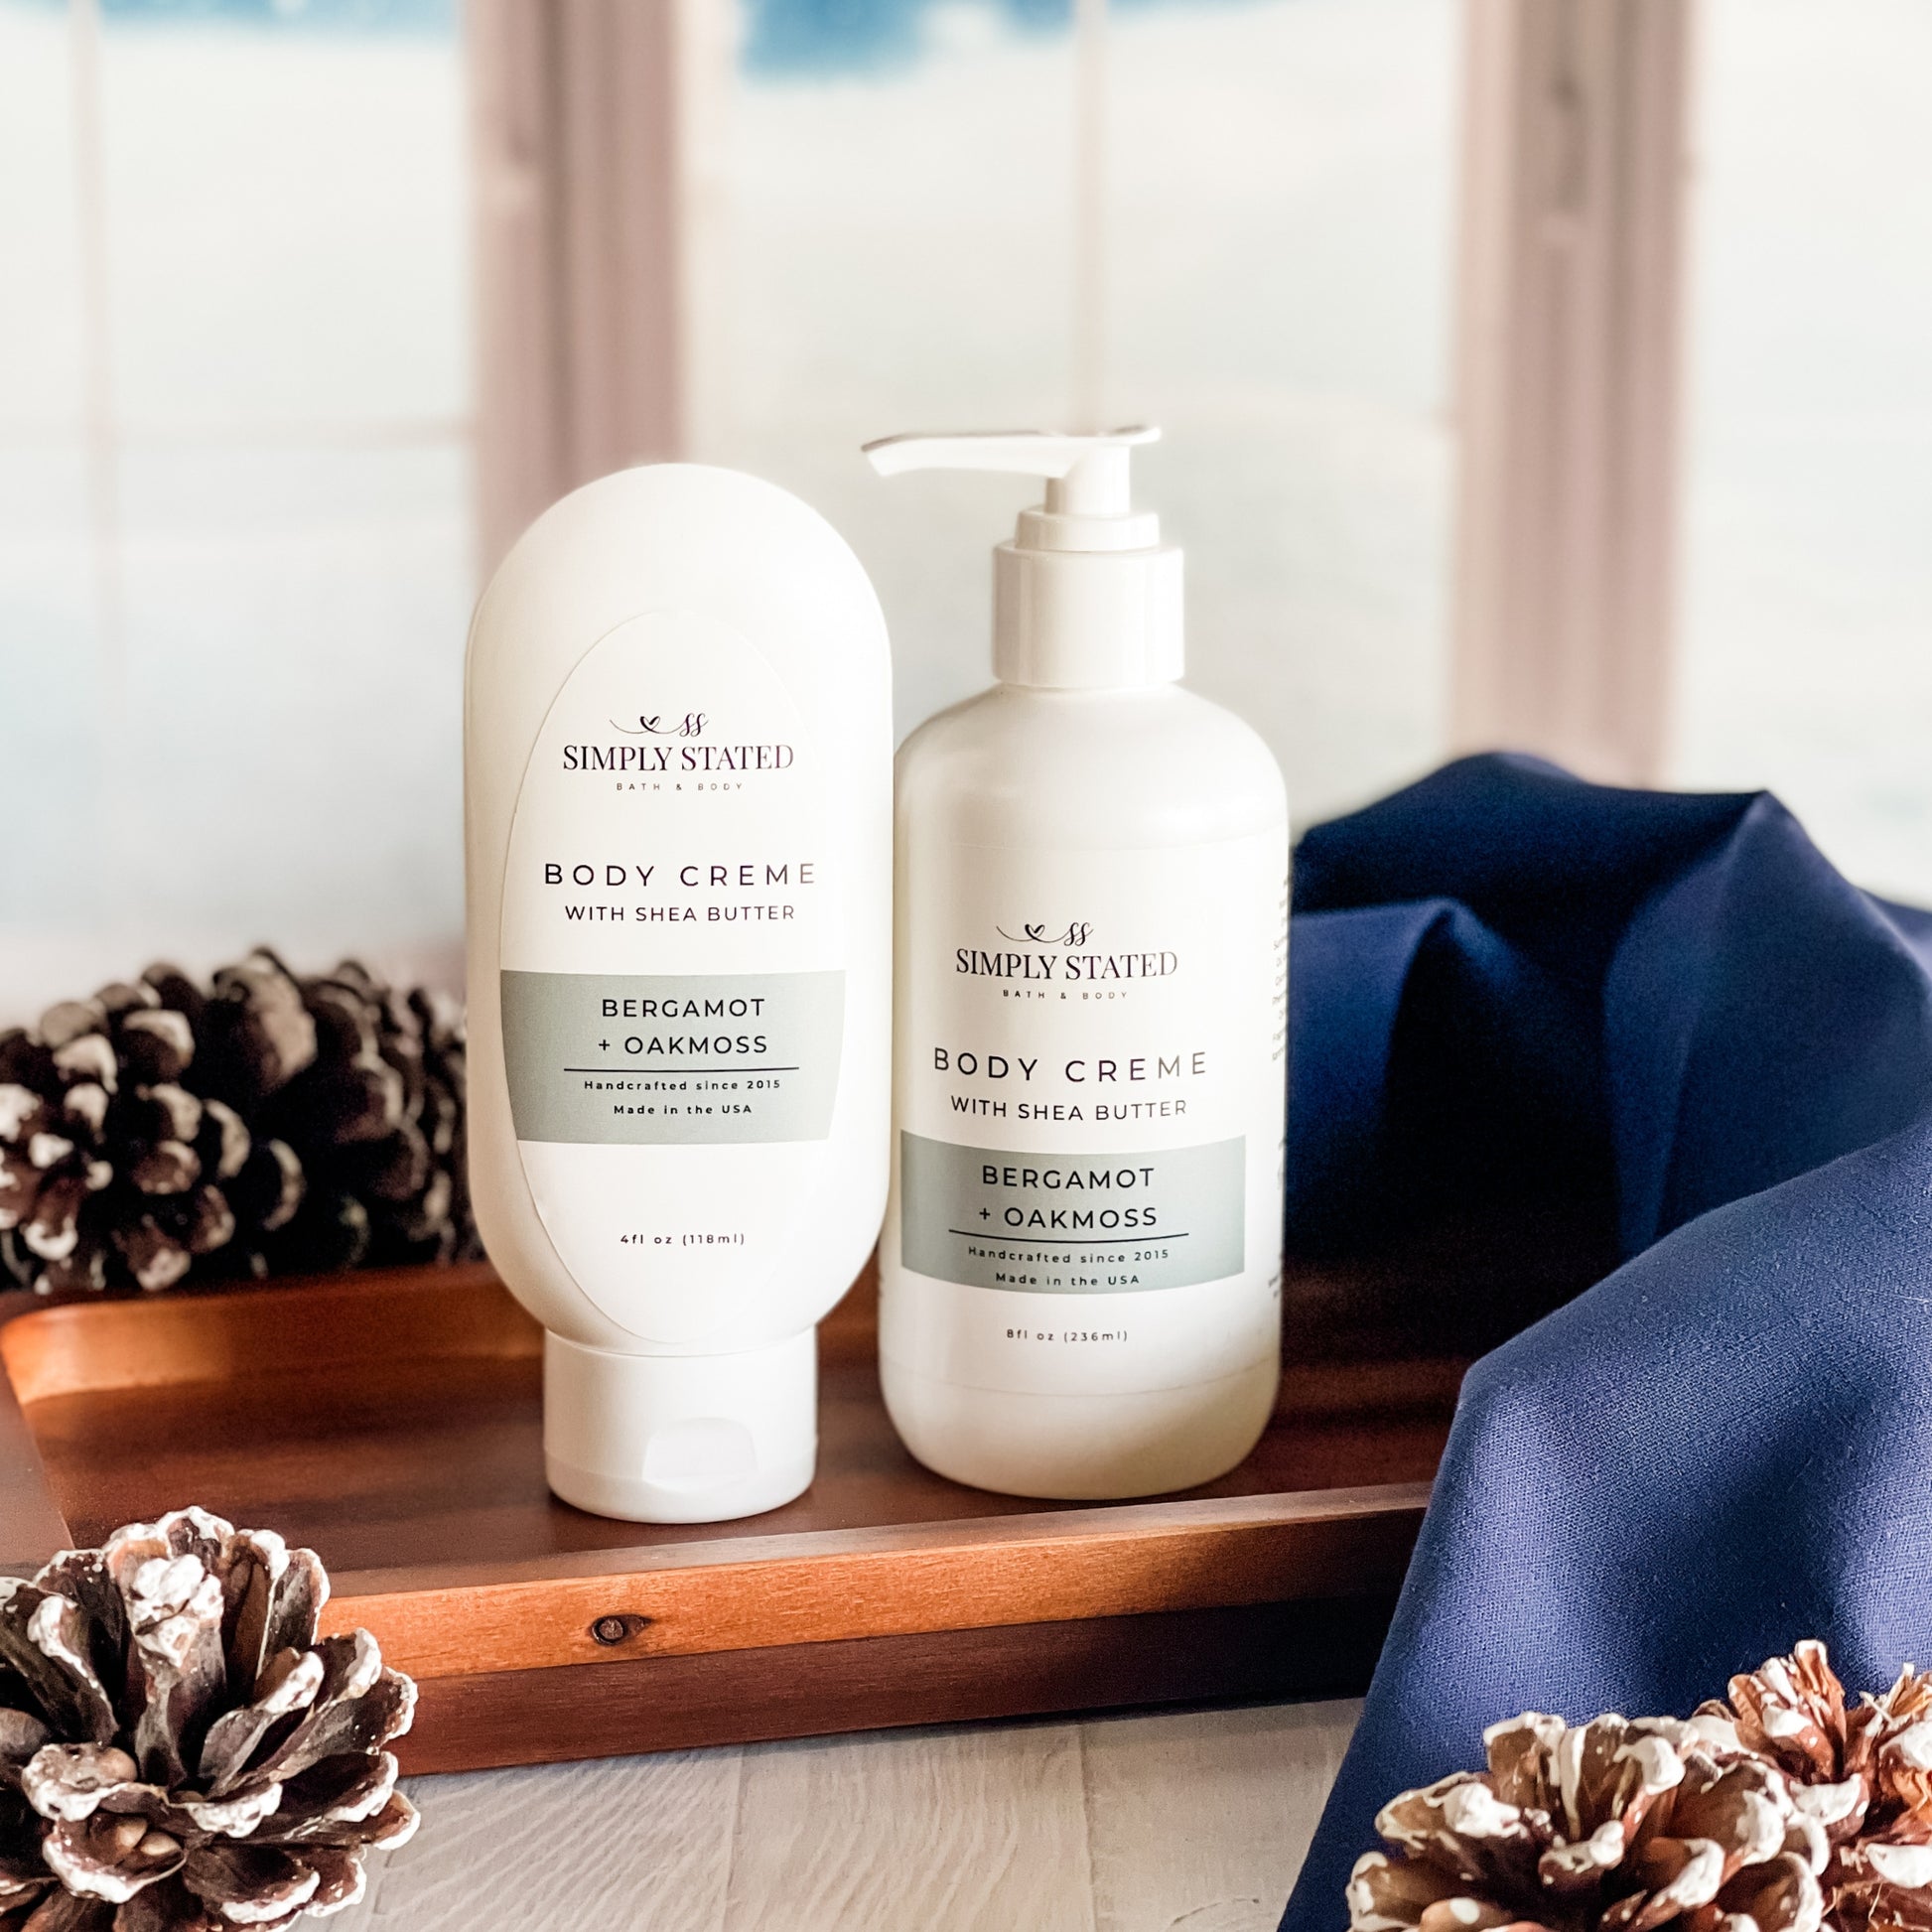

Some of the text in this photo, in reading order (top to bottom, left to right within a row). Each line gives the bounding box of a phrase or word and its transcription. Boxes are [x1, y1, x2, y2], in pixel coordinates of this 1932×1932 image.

[563, 745, 793, 771] SIMPLY STATED
[616, 782, 660, 791] BATH
[697, 782, 743, 791] BODY
[544, 863, 816, 888] BODY CREME
[564, 904, 794, 922] WITH SHEA BUTTER
[956, 948, 1177, 981] SIMPLY STATED
[1003, 989, 1045, 999] BATH
[1081, 991, 1127, 1001] BODY
[602, 998, 765, 1018] BERGAMOT
[598, 1035, 767, 1055] + OAKMOSS
[934, 1046, 1205, 1083] BODY CREME
[584, 1079, 780, 1091] Handcrafted since 2015
[614, 1104, 753, 1115] Made in the USA
[950, 1095, 1186, 1121] WITH SHEA BUTTER
[982, 1165, 1155, 1190] BERGAMOT
[978, 1206, 1157, 1230] + OAKMOSS
[620, 1233, 745, 1247] 4fl oz (118ml)
[968, 1245, 1169, 1264] Handcrafted since 2015
[995, 1272, 1140, 1287] Made in the USA
[1006, 1328, 1128, 1343] 8fl oz (236ml)
